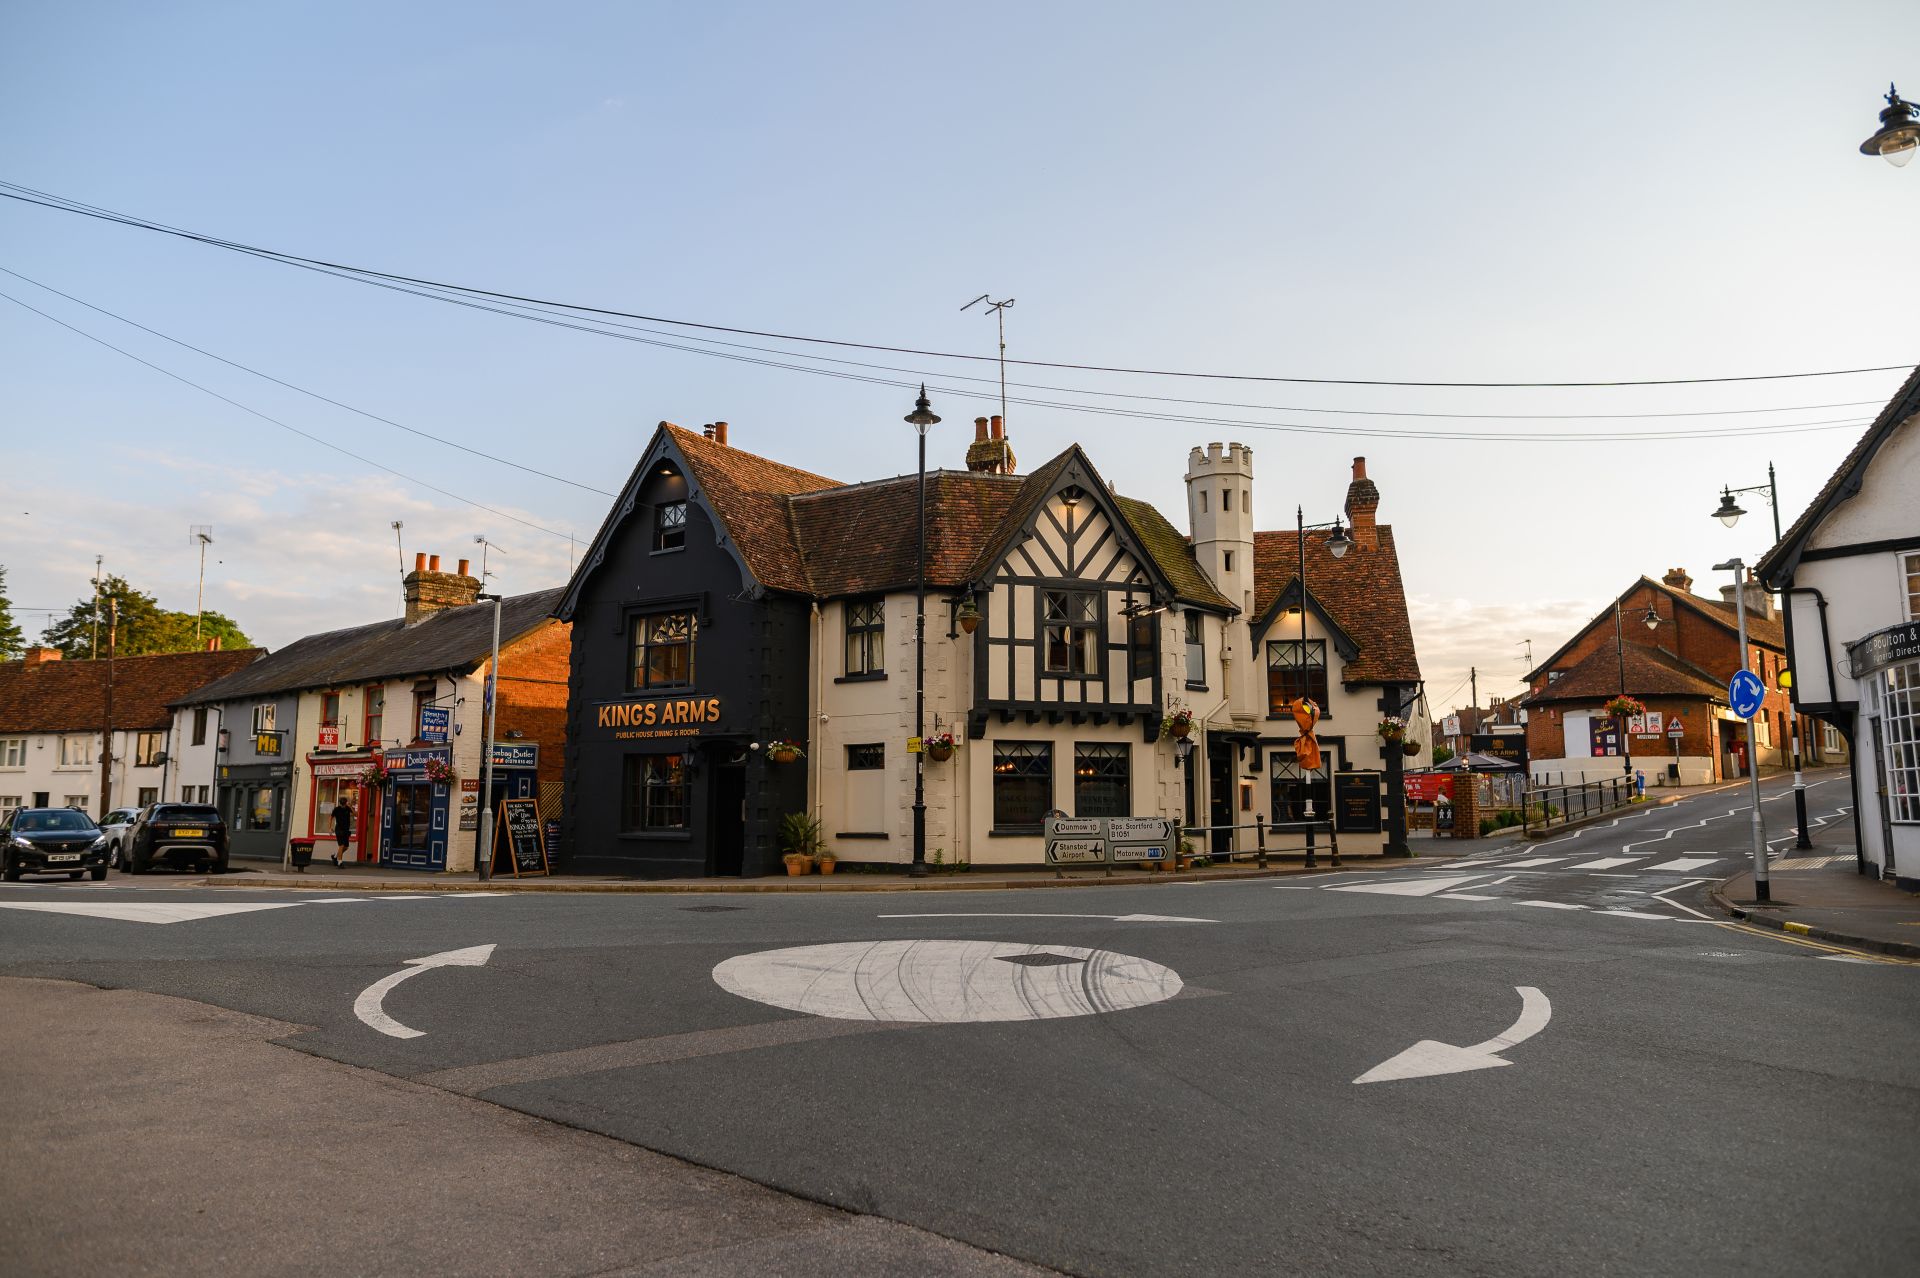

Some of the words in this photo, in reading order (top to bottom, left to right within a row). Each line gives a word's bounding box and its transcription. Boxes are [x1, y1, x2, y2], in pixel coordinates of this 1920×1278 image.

[1873, 633, 1905, 648] Poulton
[1910, 628, 1917, 641] &
[1873, 651, 1894, 663] Funeral
[598, 703, 656, 727] KINGS
[661, 699, 720, 725] ARMS
[679, 728, 700, 736] ROOMS
[513, 748, 534, 758] Butler
[1060, 843, 1088, 851] Stansted
[1116, 850, 1146, 858] Motorway
[1148, 848, 1160, 856] M11
